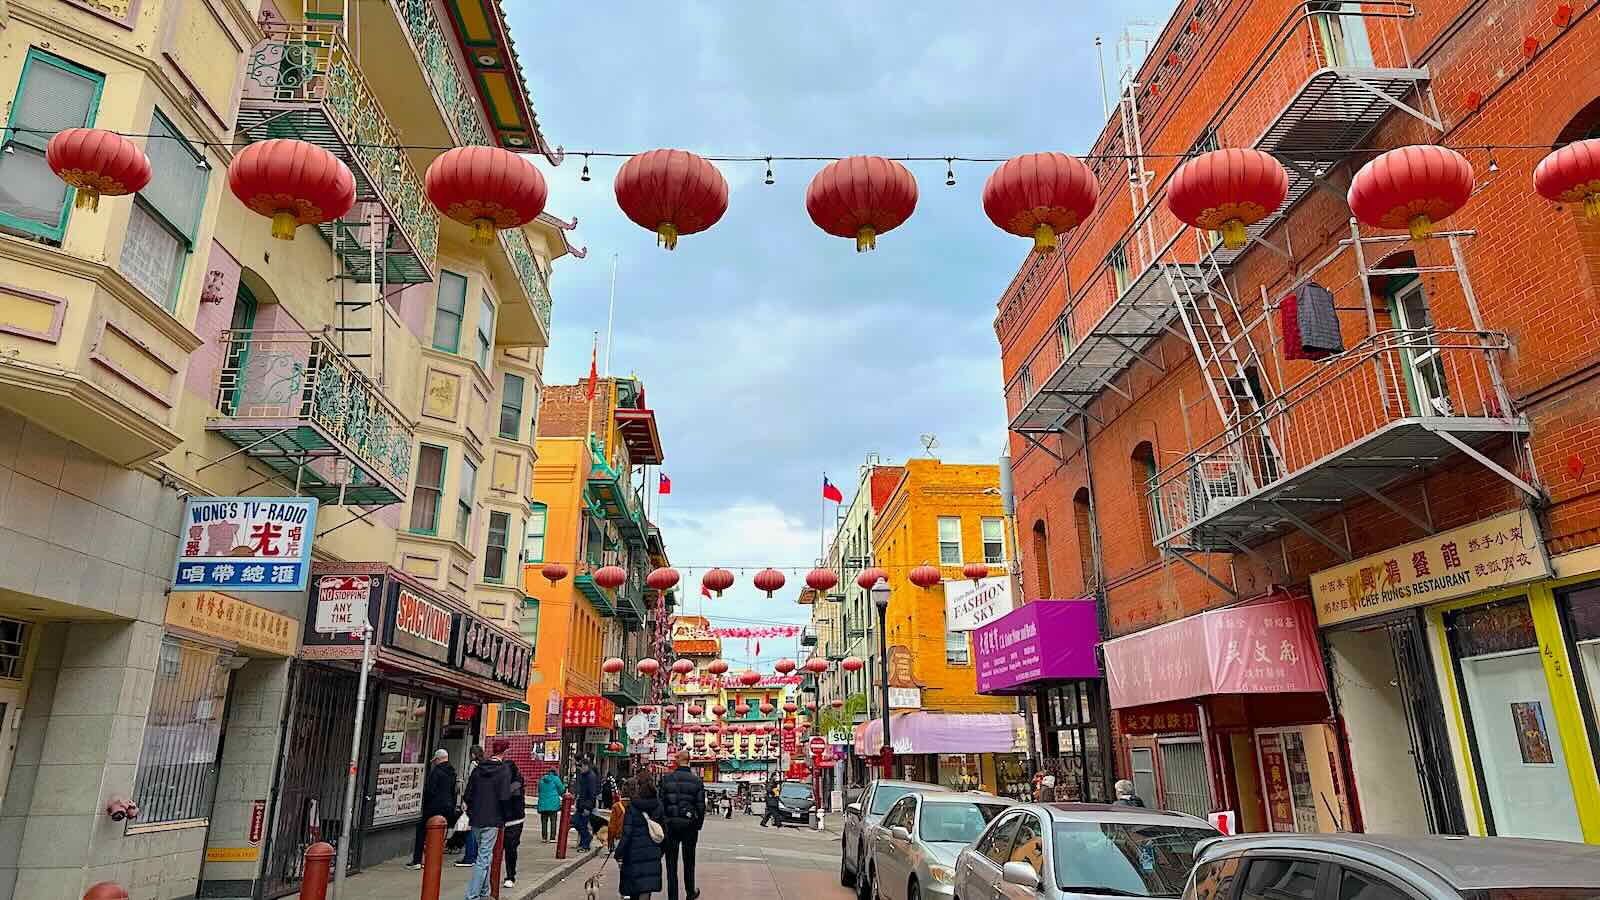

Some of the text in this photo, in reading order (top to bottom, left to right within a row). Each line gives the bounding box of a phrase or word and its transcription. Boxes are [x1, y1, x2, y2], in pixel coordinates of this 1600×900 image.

[192, 502, 308, 524] WONG'S TV-RADIO
[1412, 570, 1470, 595] RESTAURANT
[320, 588, 367, 600] NO STOPPING
[951, 583, 1005, 620] FASHION
[331, 614, 353, 623] TIME
[333, 603, 352, 612] ANY
[973, 604, 994, 626] SKY
[396, 590, 452, 648] SPICY KING
